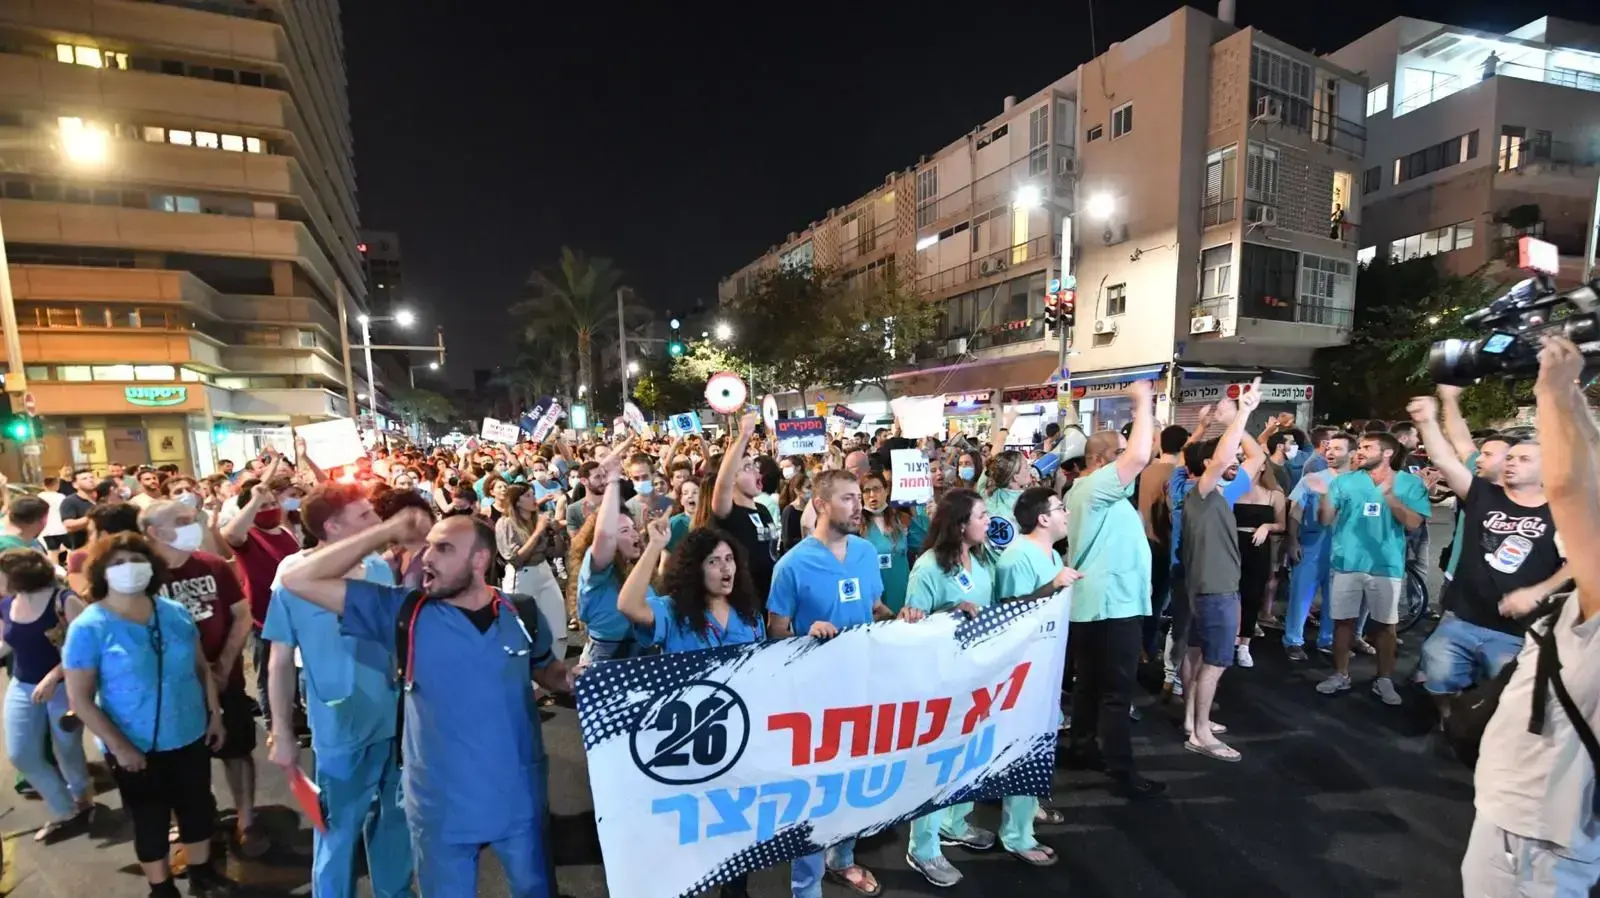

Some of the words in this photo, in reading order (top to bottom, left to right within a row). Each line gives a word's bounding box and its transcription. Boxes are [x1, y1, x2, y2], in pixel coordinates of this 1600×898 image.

[1199, 387, 1219, 398] מלך
[1271, 388, 1291, 397] הפינה
[1292, 387, 1305, 399] מלך
[778, 420, 822, 432] מפקירים
[990, 520, 1008, 540] 26
[653, 698, 729, 768] 26
[767, 697, 952, 767] נוותר
[928, 725, 995, 786] עד
[652, 758, 905, 845] שנקצר
